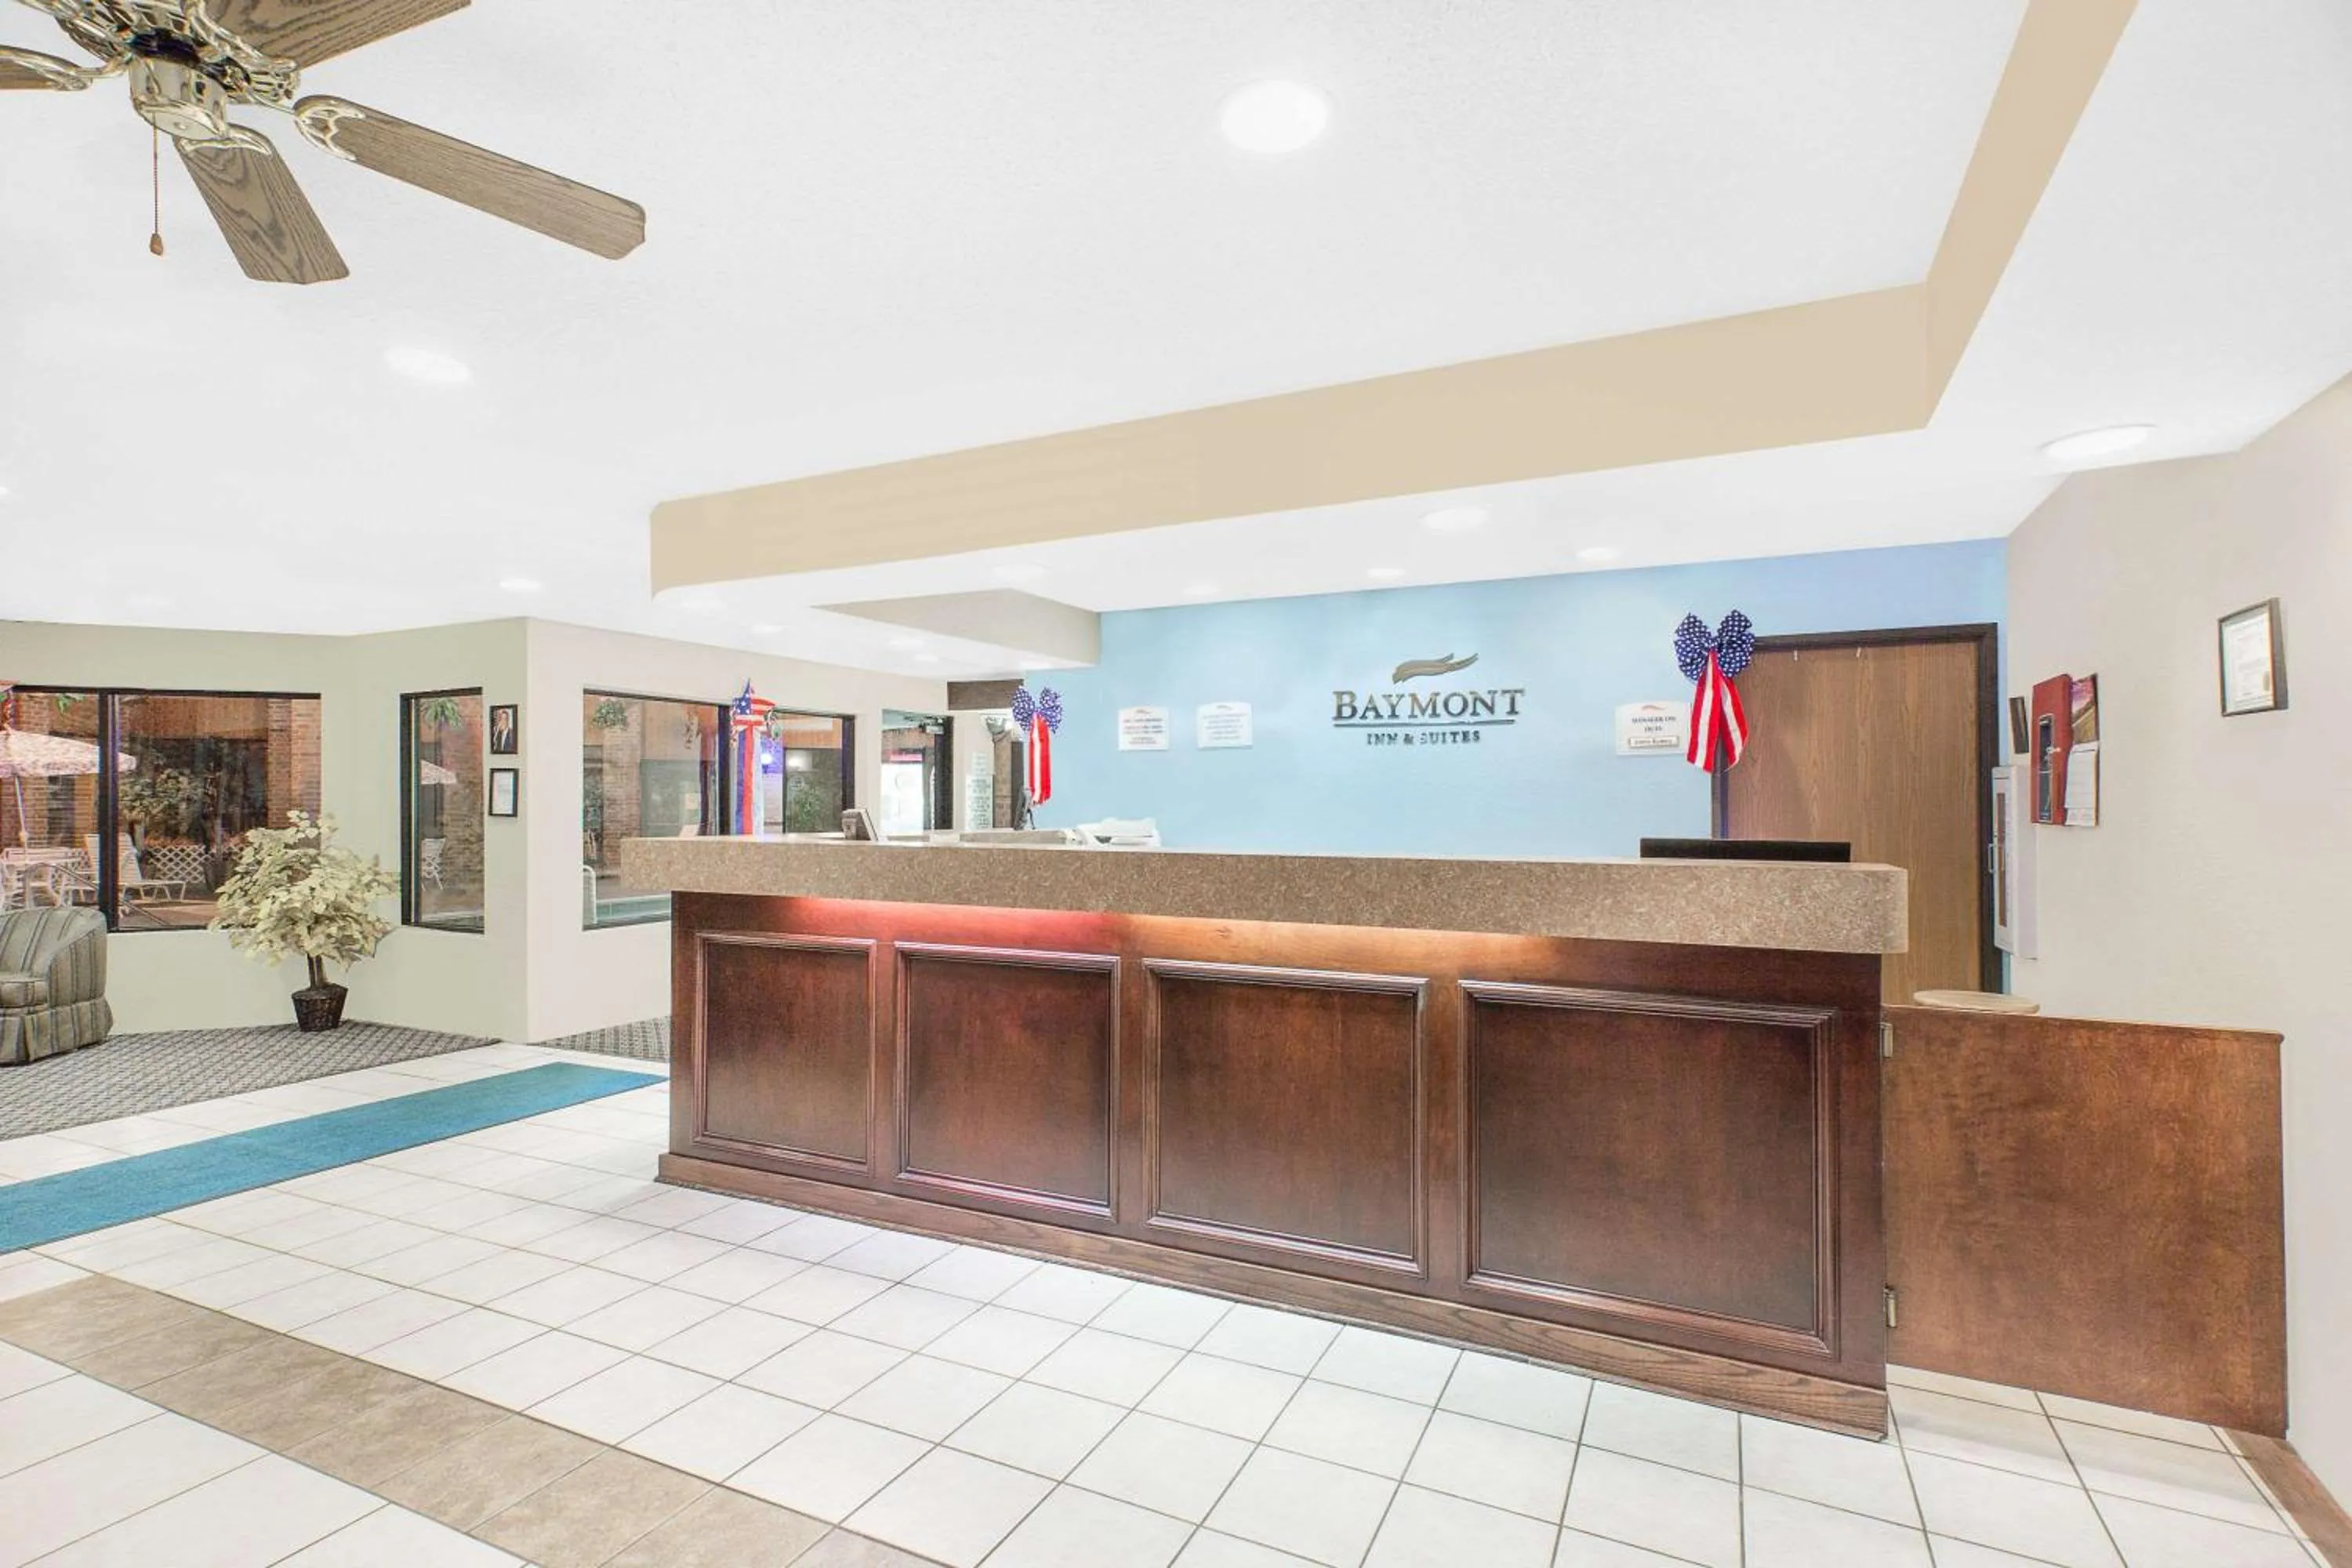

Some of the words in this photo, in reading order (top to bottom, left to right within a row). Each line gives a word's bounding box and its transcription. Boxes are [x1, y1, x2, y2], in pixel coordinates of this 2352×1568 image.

[1332, 689, 1525, 720] BAYMONT
[1367, 733, 1398, 746] INN
[1403, 733, 1414, 745] &
[1420, 730, 1481, 746] SUITES
